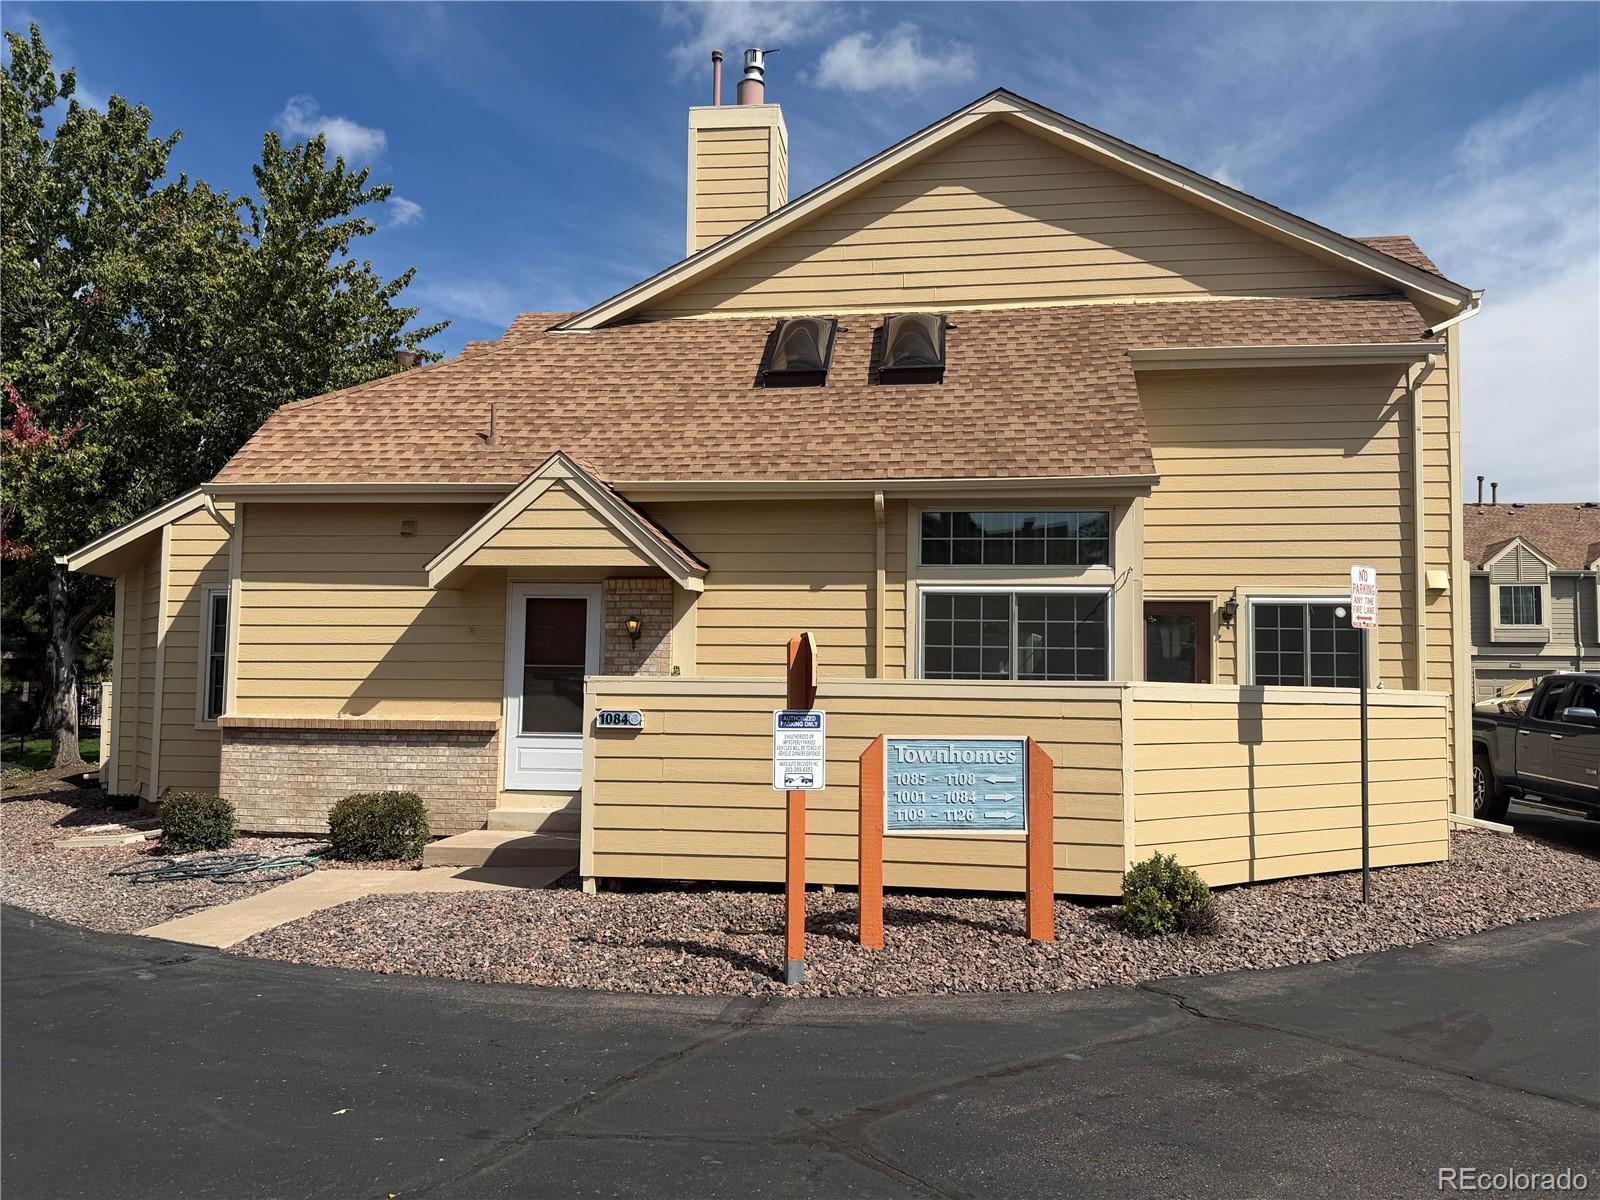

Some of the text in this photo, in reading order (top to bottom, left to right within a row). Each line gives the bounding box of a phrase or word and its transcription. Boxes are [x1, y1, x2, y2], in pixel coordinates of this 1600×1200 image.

[1358, 570, 1368, 582] NO
[1353, 583, 1375, 596] PARKING
[1353, 596, 1363, 604] ANY
[1364, 606, 1375, 615] LANE
[599, 713, 629, 725] 1084
[894, 744, 1016, 764] Townhomes
[894, 772, 926, 785] 1085
[944, 773, 976, 786] 1108
[894, 791, 926, 804] 1001
[944, 791, 976, 804] 1084
[894, 809, 926, 822] 1109
[944, 808, 975, 822] 1126
